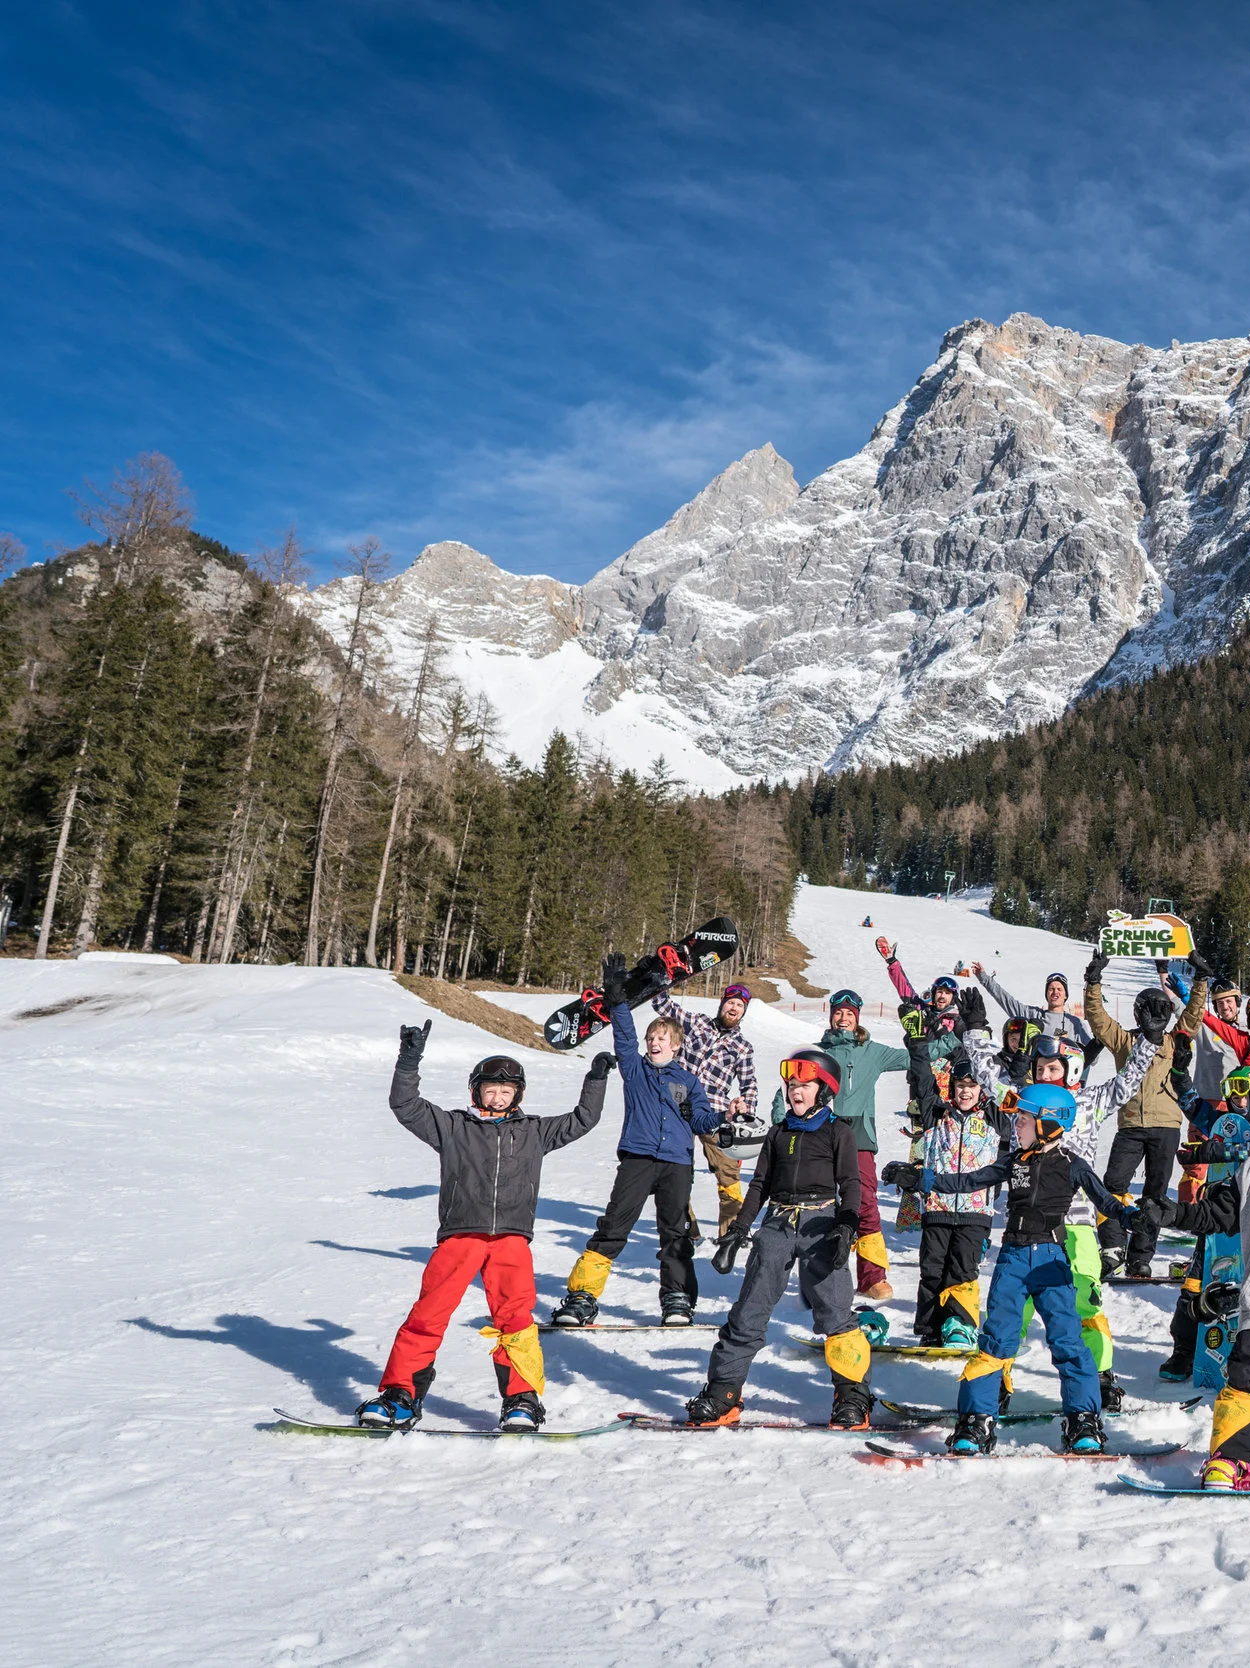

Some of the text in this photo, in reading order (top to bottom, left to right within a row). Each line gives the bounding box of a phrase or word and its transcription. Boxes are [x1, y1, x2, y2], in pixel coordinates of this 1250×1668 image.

[694, 931, 737, 943] MARKER
[1102, 928, 1173, 942] SPRUNG
[1101, 940, 1176, 957] BRETT
[570, 1012, 580, 1045] adidas
